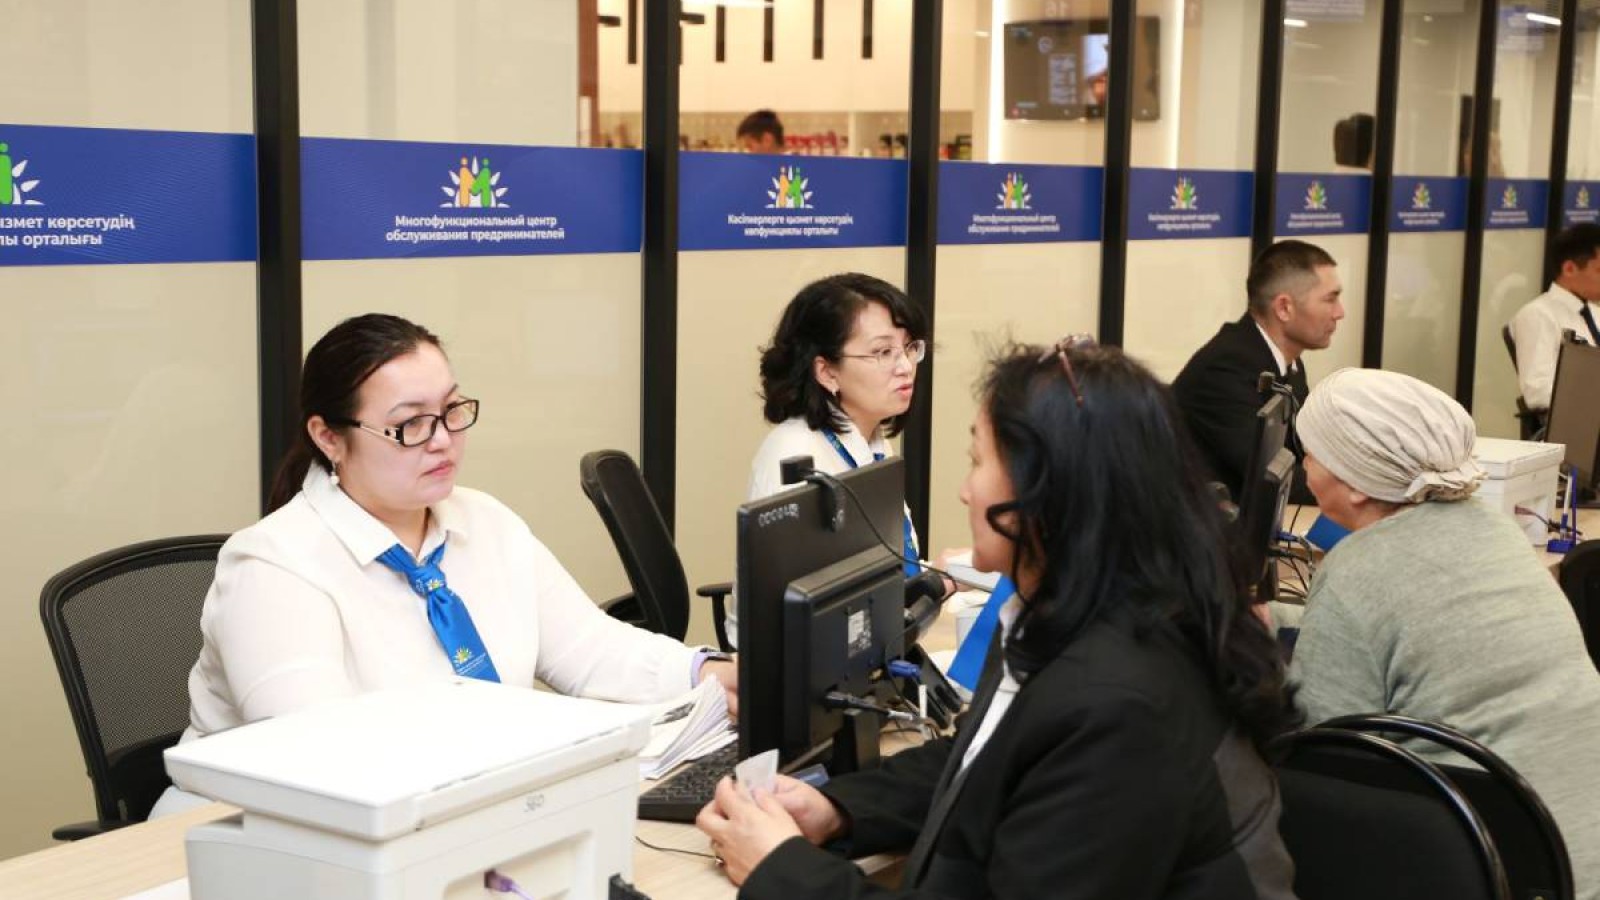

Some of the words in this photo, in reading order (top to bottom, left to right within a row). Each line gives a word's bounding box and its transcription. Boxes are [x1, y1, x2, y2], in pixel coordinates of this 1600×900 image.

[47, 214, 136, 231] көрсетудің
[395, 214, 525, 229] Многофункциональный
[527, 216, 557, 228] центр
[22, 234, 102, 249] орталығы
[385, 229, 469, 243] обслуживания
[471, 228, 565, 242] предпринимателей
